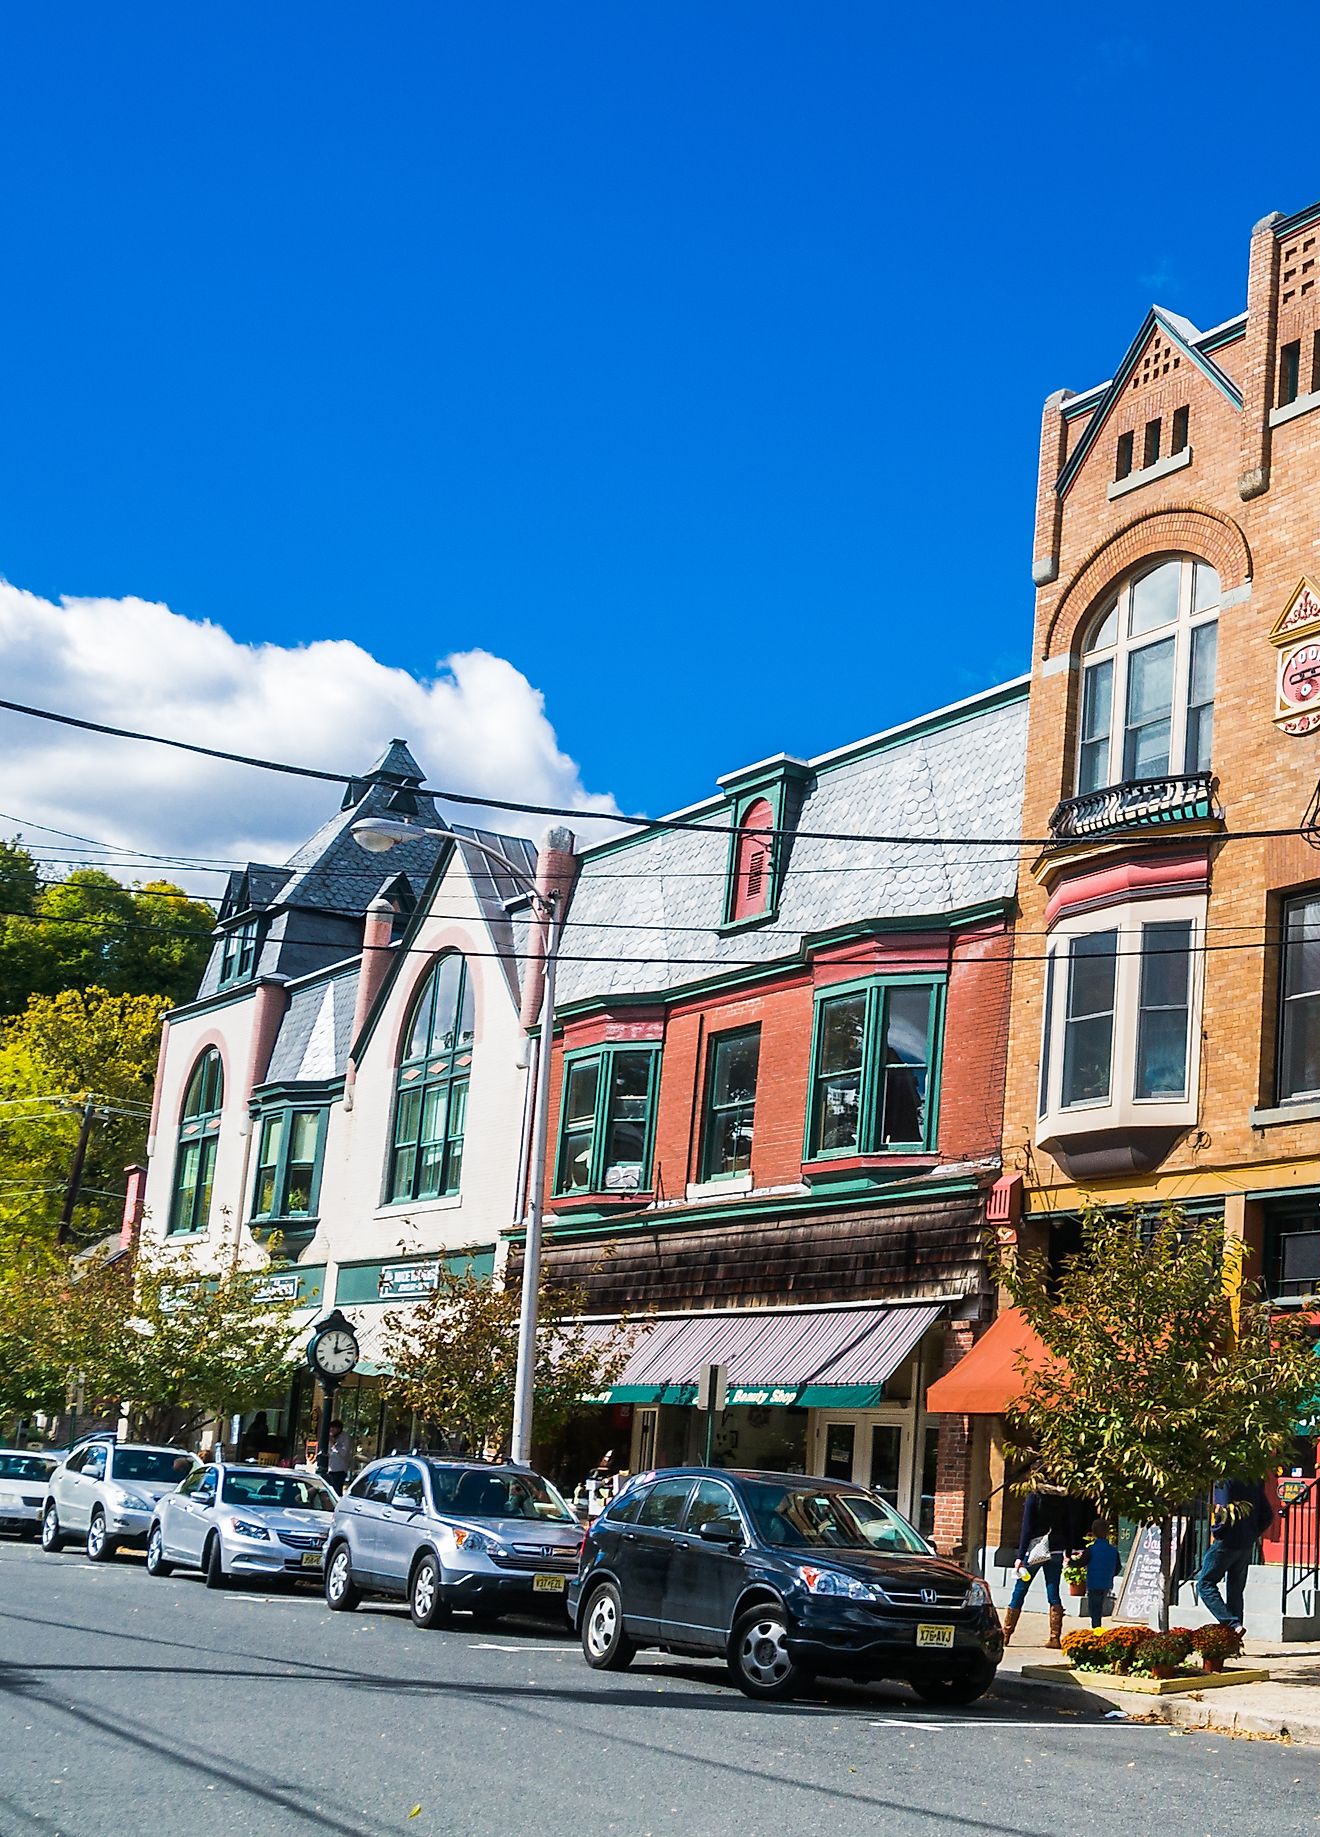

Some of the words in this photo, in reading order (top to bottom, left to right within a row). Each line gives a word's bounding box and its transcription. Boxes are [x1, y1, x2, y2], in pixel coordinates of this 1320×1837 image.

[733, 1389, 769, 1406] Beauty
[769, 1389, 797, 1405] Shop
[1120, 1528, 1131, 1540] 36
